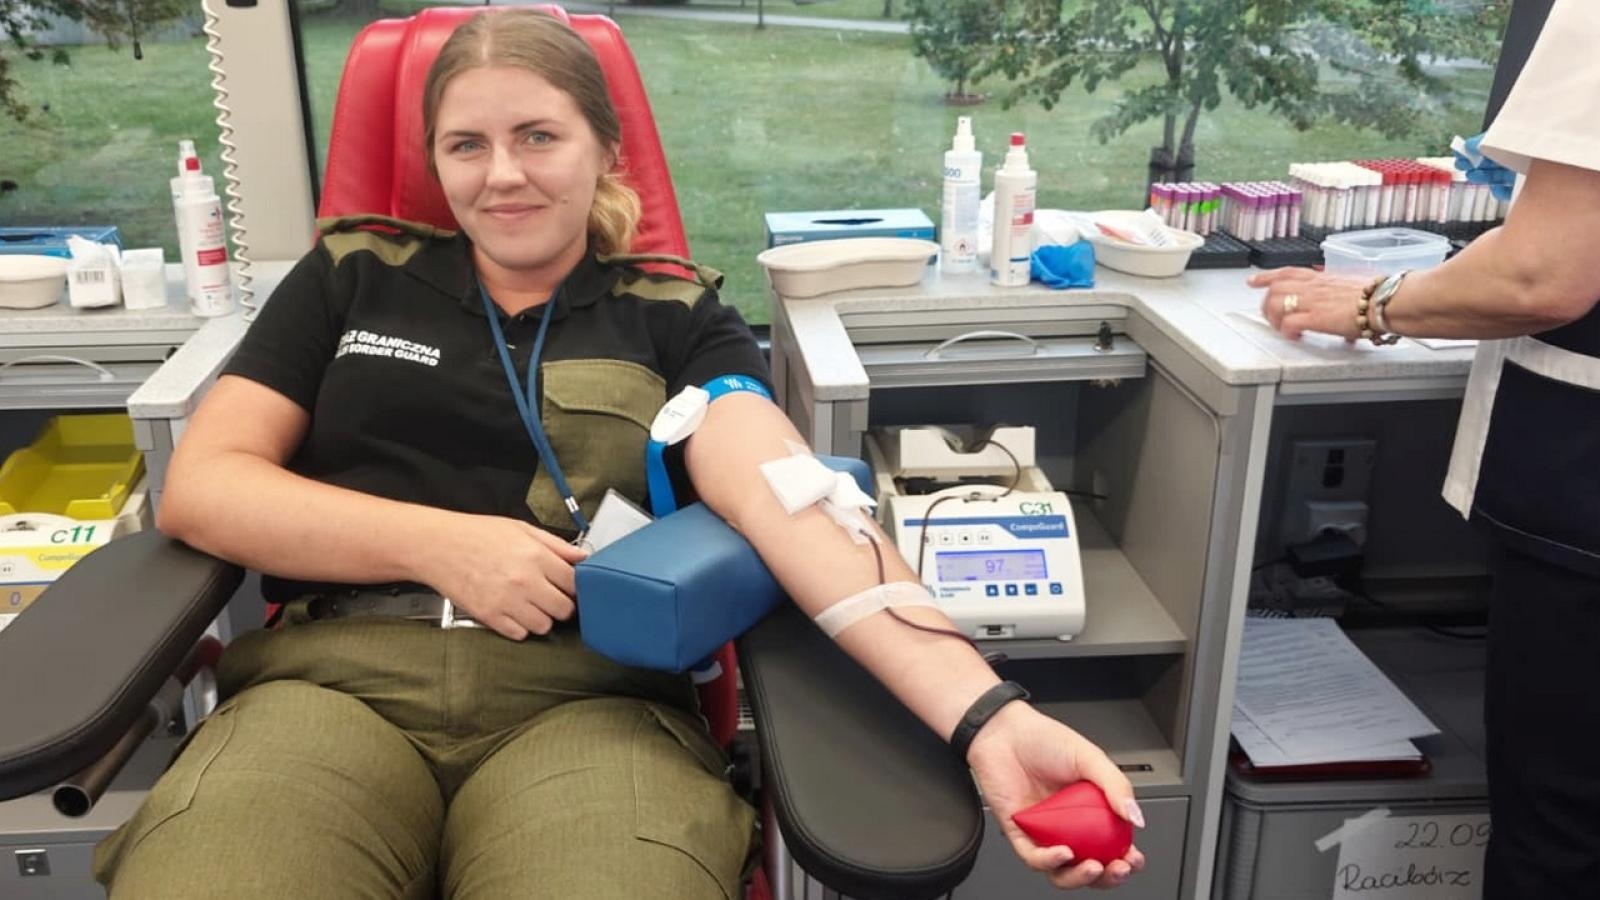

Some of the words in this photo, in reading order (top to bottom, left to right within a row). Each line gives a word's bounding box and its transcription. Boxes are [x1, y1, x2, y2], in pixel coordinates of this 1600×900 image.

[349, 343, 393, 357] BORDER
[394, 349, 439, 366] GUARD
[357, 330, 440, 359] GRANICZNA
[985, 558, 1006, 573] 97
